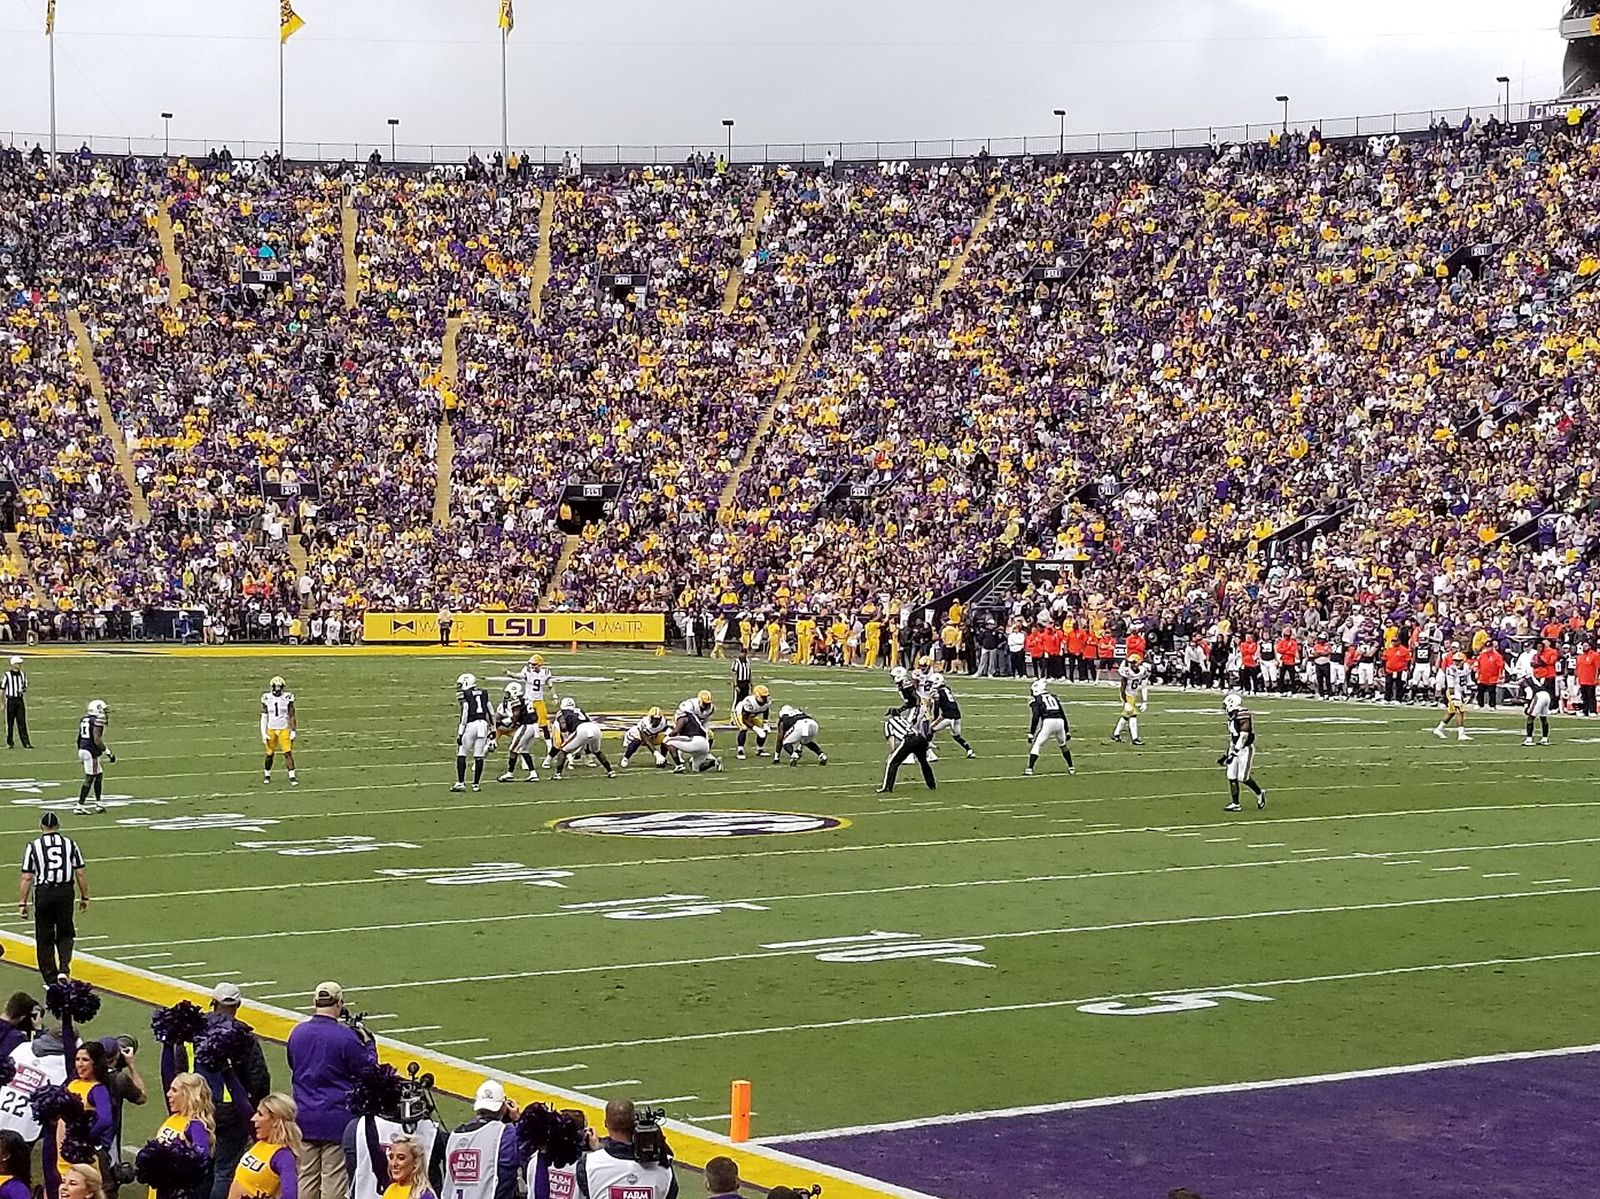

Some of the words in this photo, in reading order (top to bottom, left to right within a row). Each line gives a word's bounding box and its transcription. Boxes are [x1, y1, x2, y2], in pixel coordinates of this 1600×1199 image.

[486, 618, 546, 637] LSU
[533, 679, 540, 691] 9
[48, 846, 63, 870] S
[1, 1091, 29, 1118] 22
